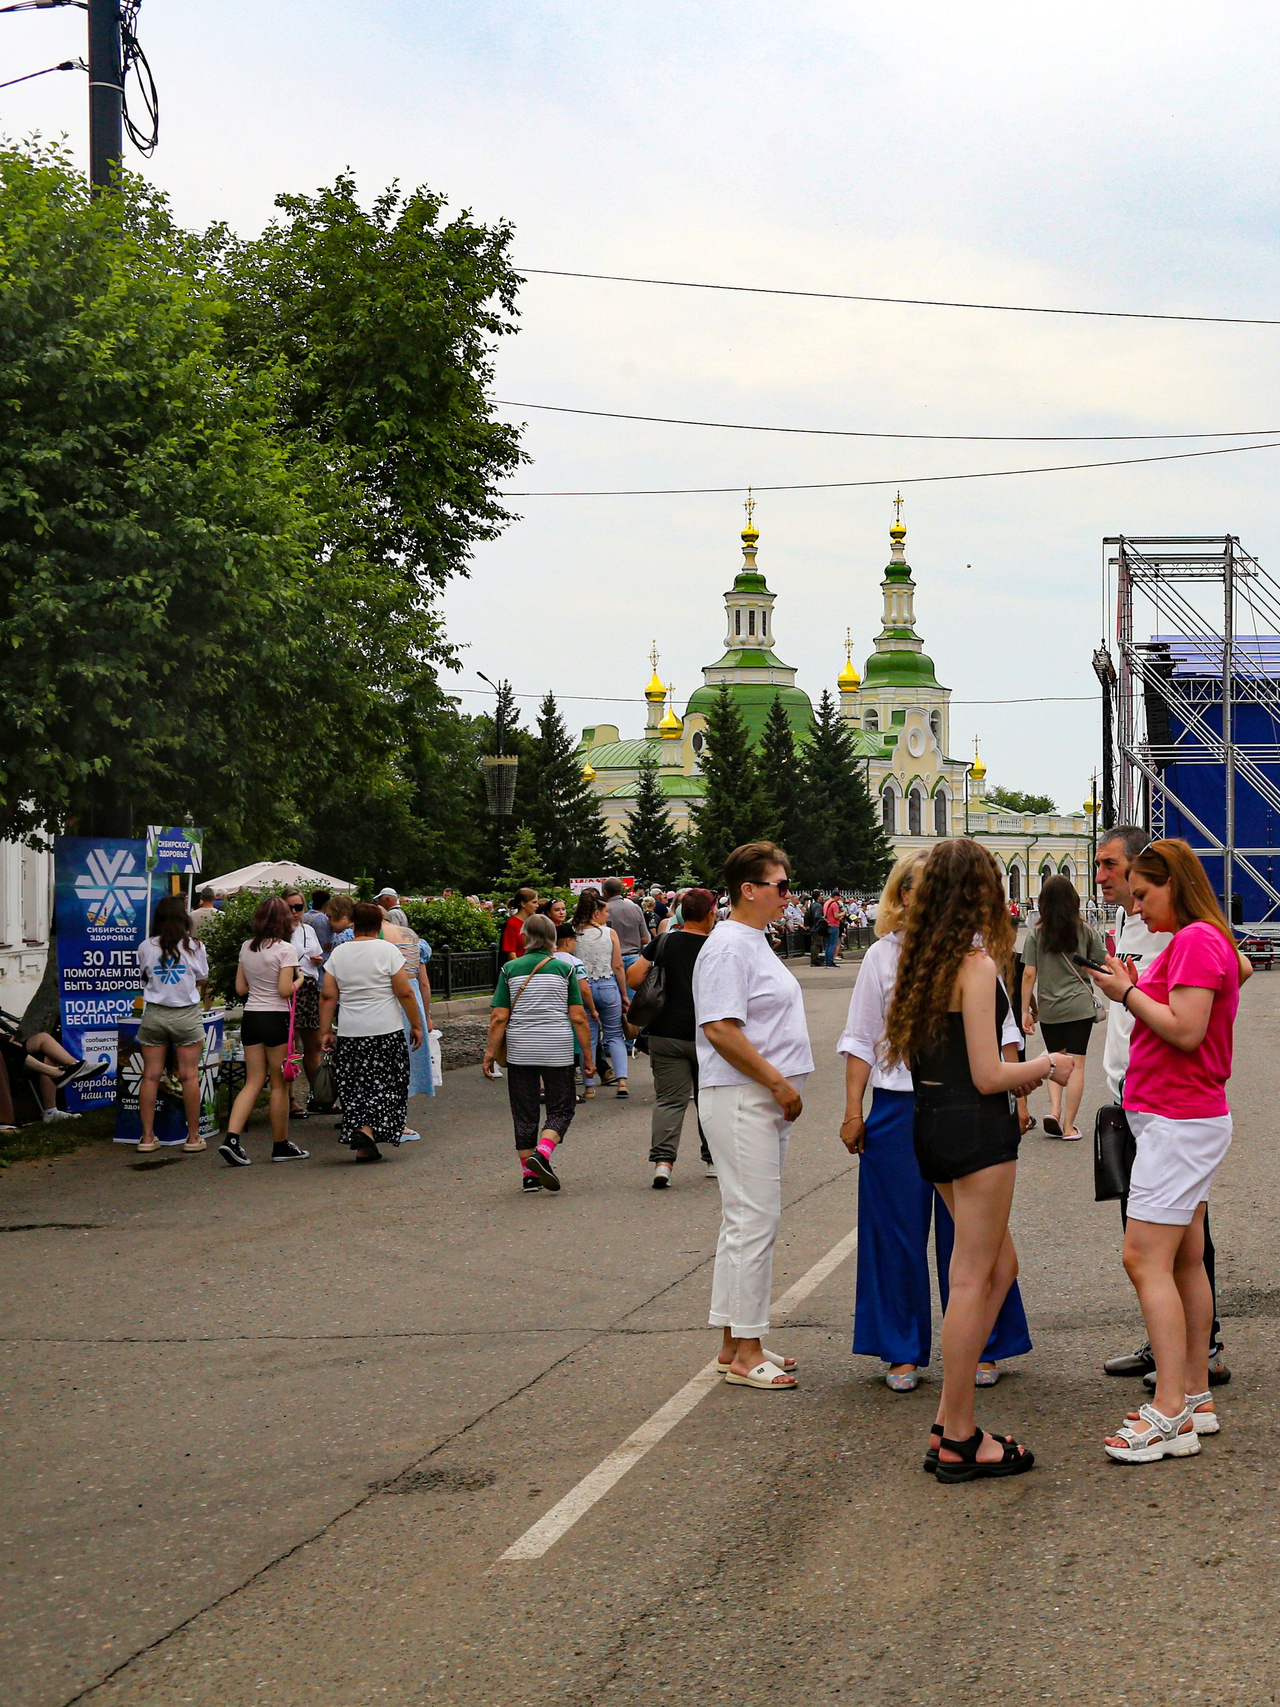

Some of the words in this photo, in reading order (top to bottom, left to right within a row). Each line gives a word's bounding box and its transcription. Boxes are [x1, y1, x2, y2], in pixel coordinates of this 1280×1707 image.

[157, 840, 191, 849] СИБИРСКОЕ
[159, 850, 188, 858] ЗДОРОВЬЕ
[86, 926, 138, 934] СИБИРСКОЕ
[90, 934, 135, 942] ЗДОРОВЬЕ
[83, 950, 105, 966] 30
[63, 968, 121, 978] ПОМОГАЕМ
[64, 981, 93, 991] БЫТЬ
[81, 1092, 103, 1100] наш
